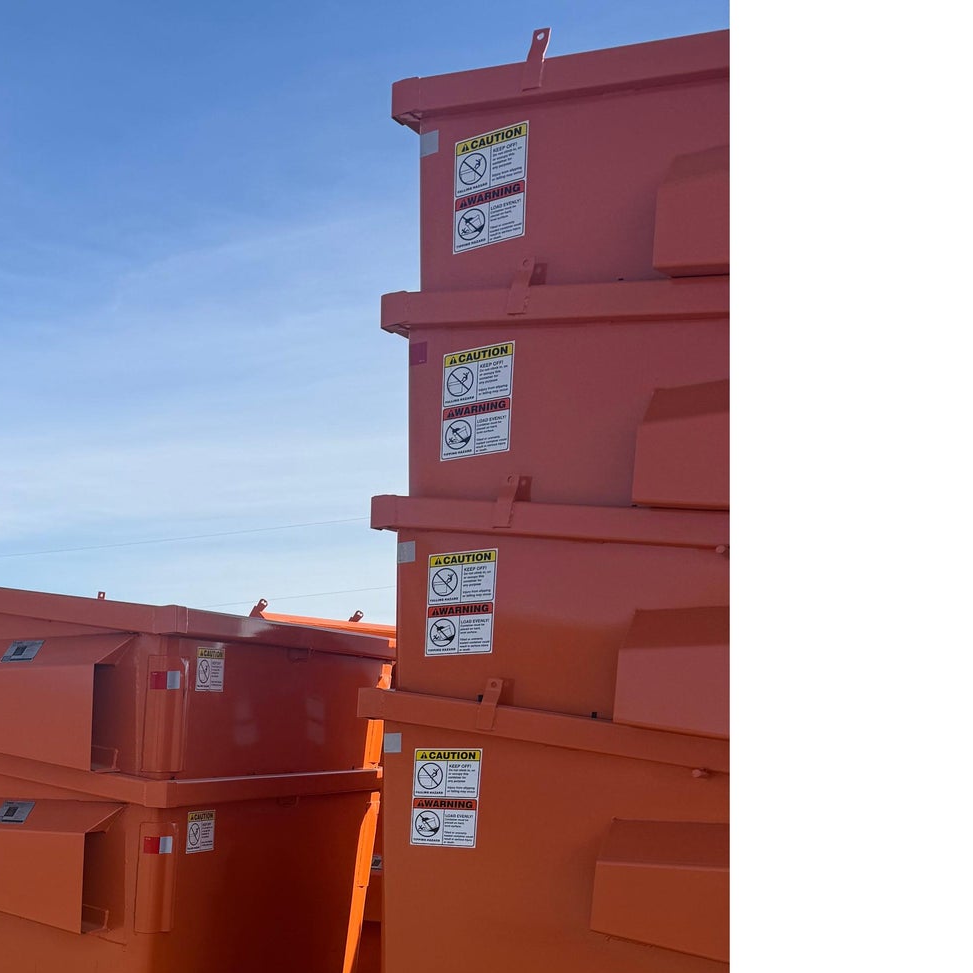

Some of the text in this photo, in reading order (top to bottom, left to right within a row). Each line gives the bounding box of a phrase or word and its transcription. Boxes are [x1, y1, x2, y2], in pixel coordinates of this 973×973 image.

[471, 127, 522, 151] CAUTION
[467, 184, 520, 205] WARNING
[459, 346, 508, 363] CAUTION
[455, 400, 506, 416] WARNING
[443, 552, 491, 565] CAUTION
[440, 605, 489, 615] WARNING
[429, 752, 476, 760] CAUTION
[425, 800, 473, 809] WARNING
